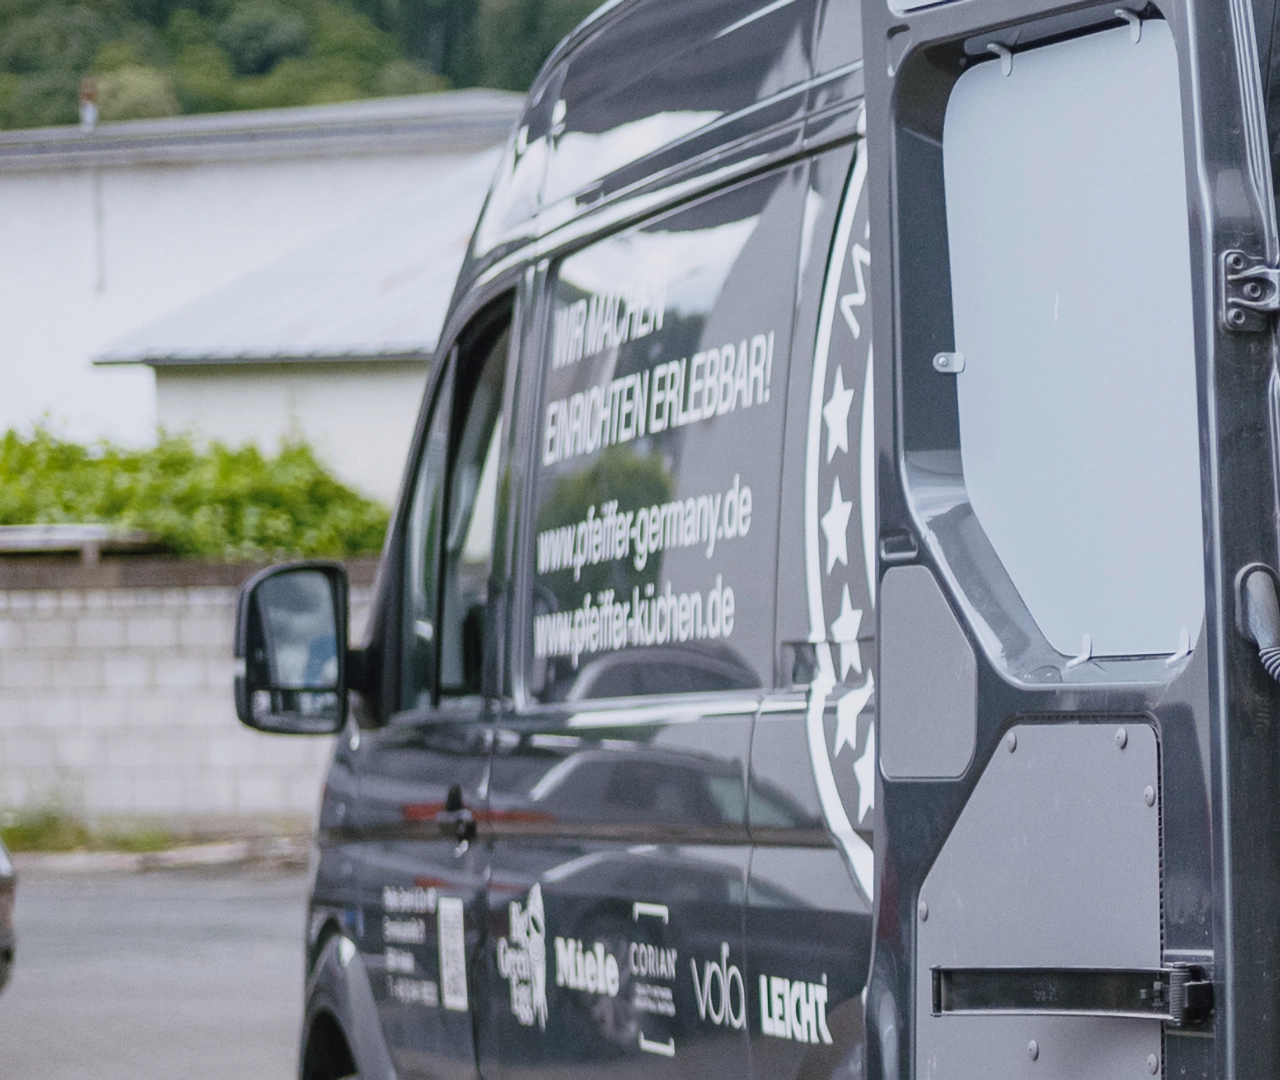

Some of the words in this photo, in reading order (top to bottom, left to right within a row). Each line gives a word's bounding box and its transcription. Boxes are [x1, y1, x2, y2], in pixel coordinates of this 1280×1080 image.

[552, 298, 587, 371] WIR
[584, 275, 665, 357] MACHEN
[542, 368, 650, 467] EINRICHTEN
[650, 331, 775, 434] ERLEBBAR!
[537, 473, 753, 583] www.pfeiffer-germany.de
[534, 573, 735, 669] www.pfeiffer-küchen.de
[554, 936, 620, 998] Miele
[628, 942, 677, 980] CORIAN
[759, 973, 833, 1045] LEICHT
